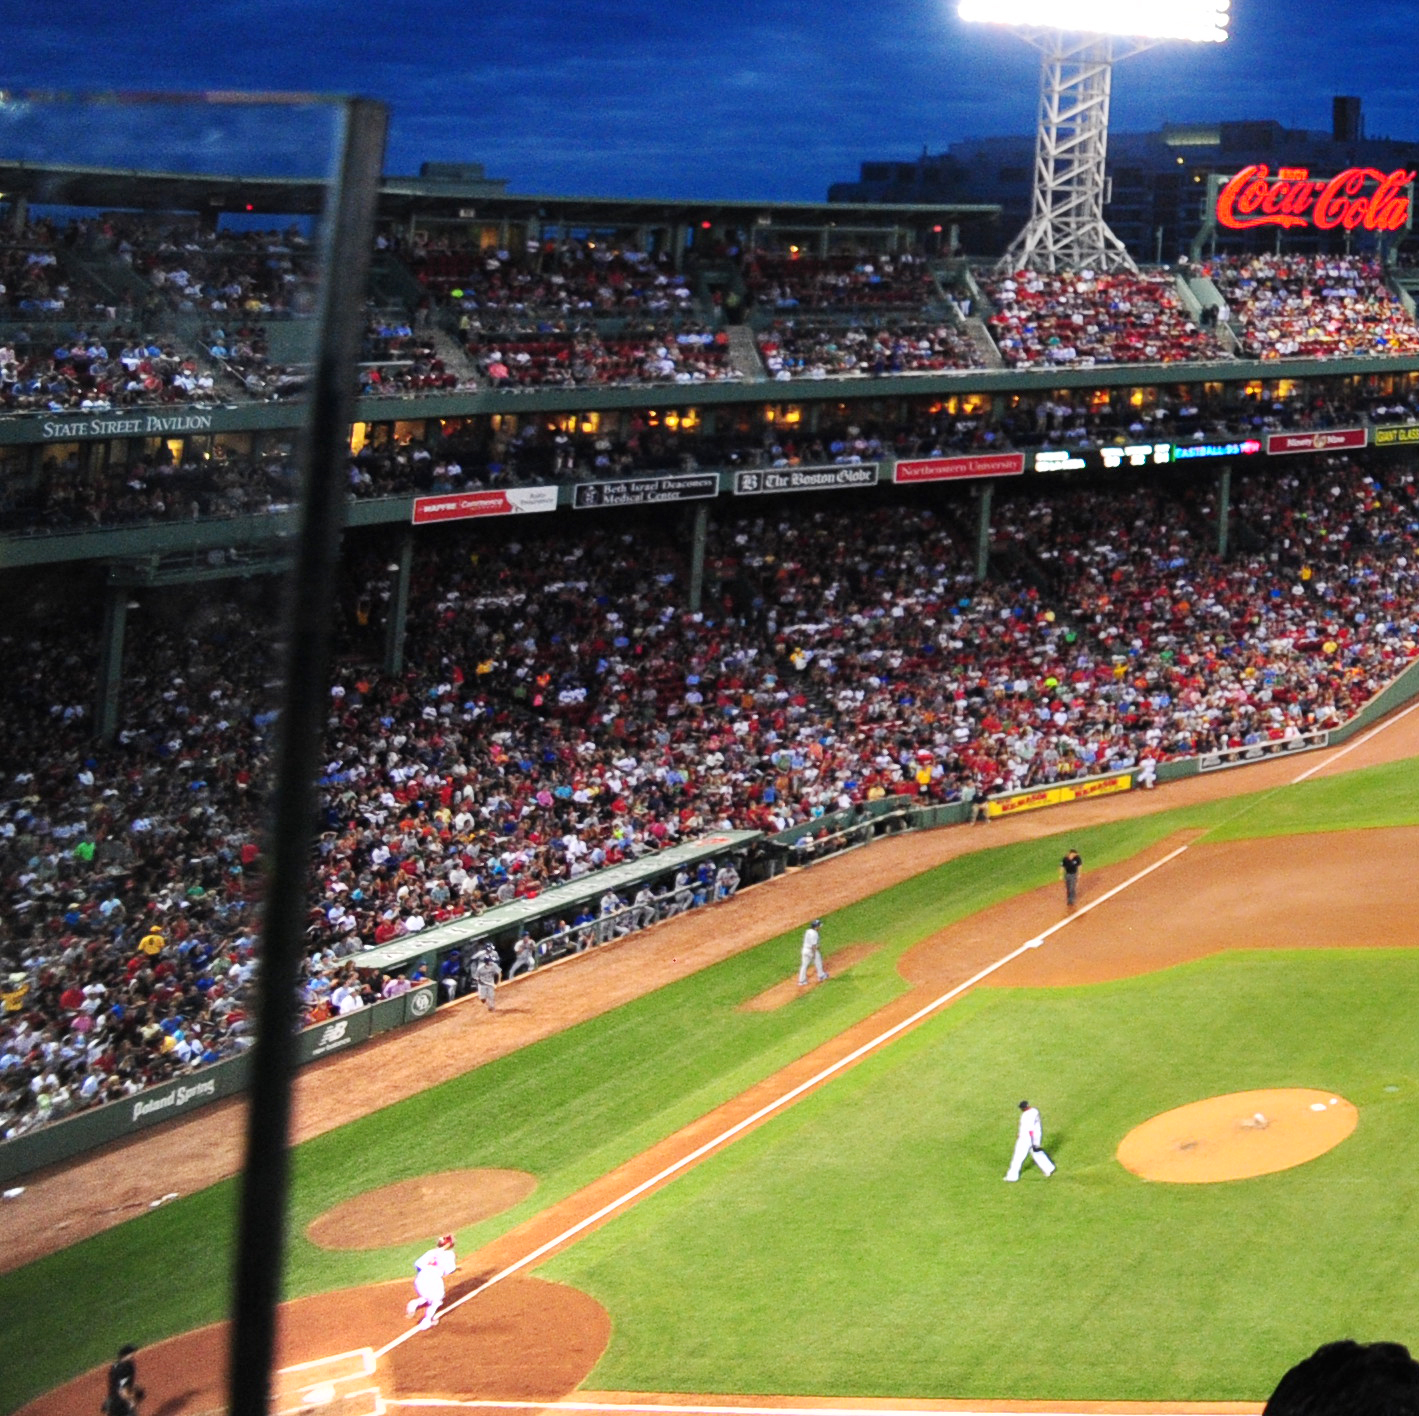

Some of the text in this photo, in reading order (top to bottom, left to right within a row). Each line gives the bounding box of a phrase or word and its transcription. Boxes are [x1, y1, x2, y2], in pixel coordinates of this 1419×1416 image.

[1216, 163, 1417, 231] Coca-Cola
[43, 415, 213, 438] STATE STREET PAVILION
[1399, 429, 1419, 440] GLASS
[902, 459, 1018, 476] Northeastern University
[603, 478, 712, 495] Beth Israel Deaconess
[765, 470, 872, 488] The Boston Globe
[603, 490, 681, 504] Medical Center
[132, 1079, 215, 1121] Poland Spring
